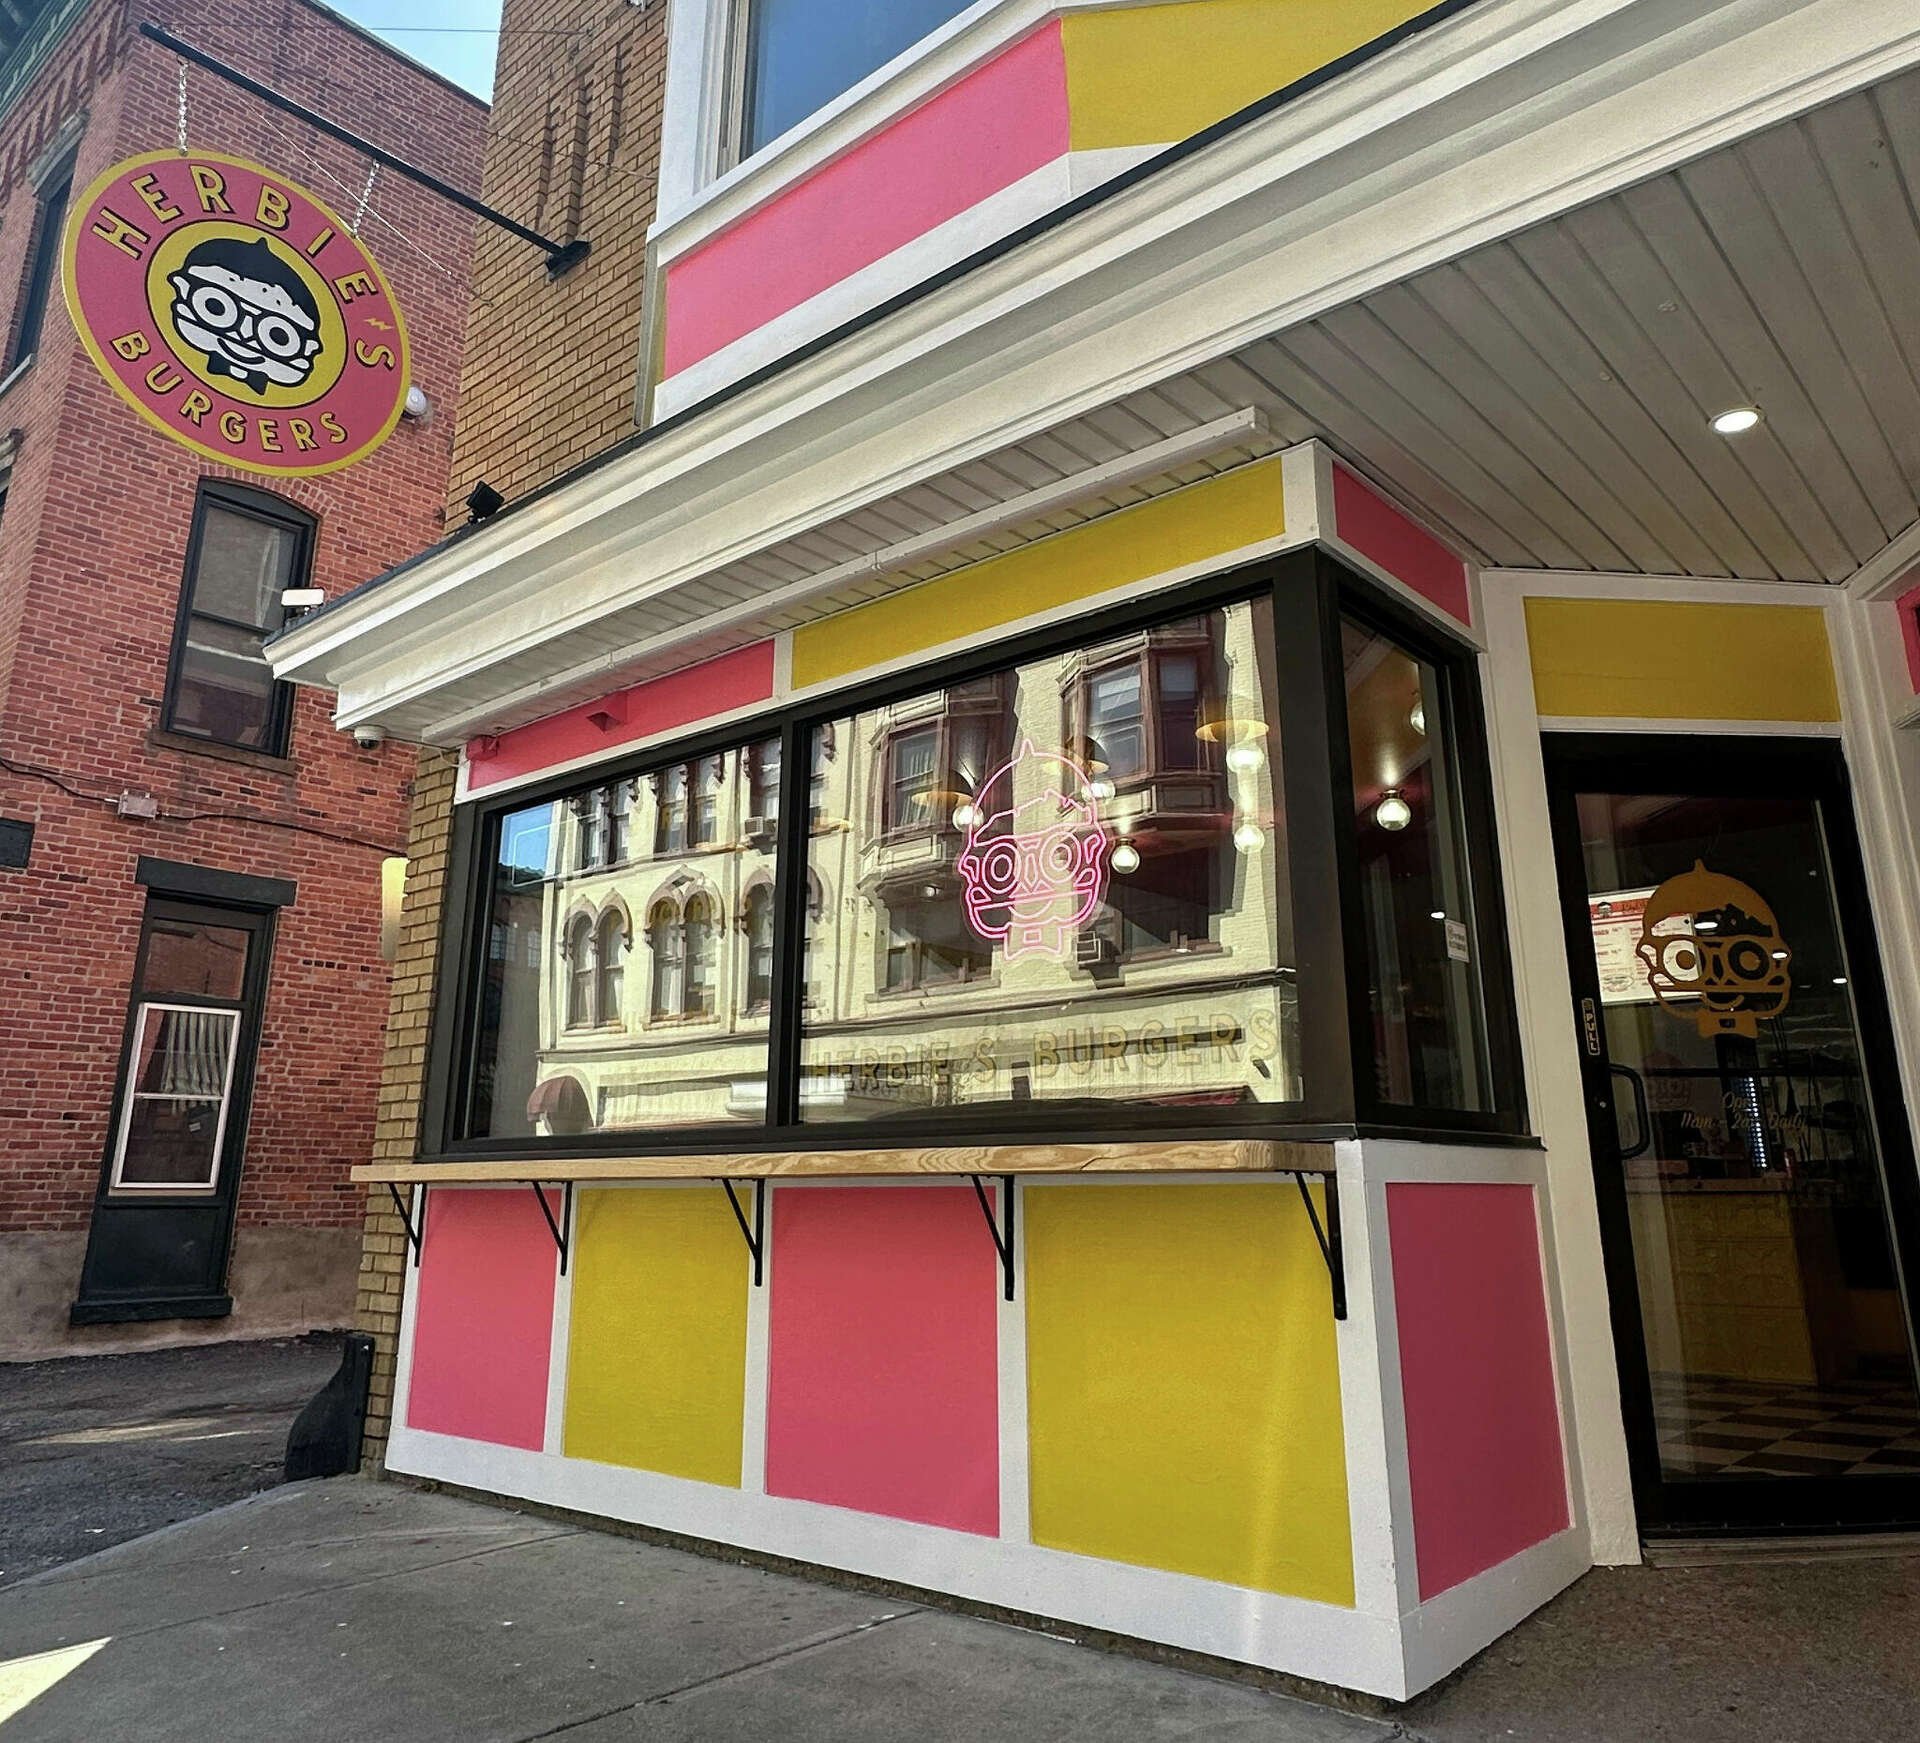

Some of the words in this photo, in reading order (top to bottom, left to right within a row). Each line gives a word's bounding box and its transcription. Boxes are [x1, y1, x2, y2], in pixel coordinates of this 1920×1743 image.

[92, 165, 396, 371] HERBIE'S
[111, 330, 348, 452] BURGERS
[811, 1037, 998, 1090] HERBIES
[1032, 1008, 1282, 1080] BURGERS
[1585, 1013, 1598, 1051] PULL
[1721, 1091, 1760, 1112] Op
